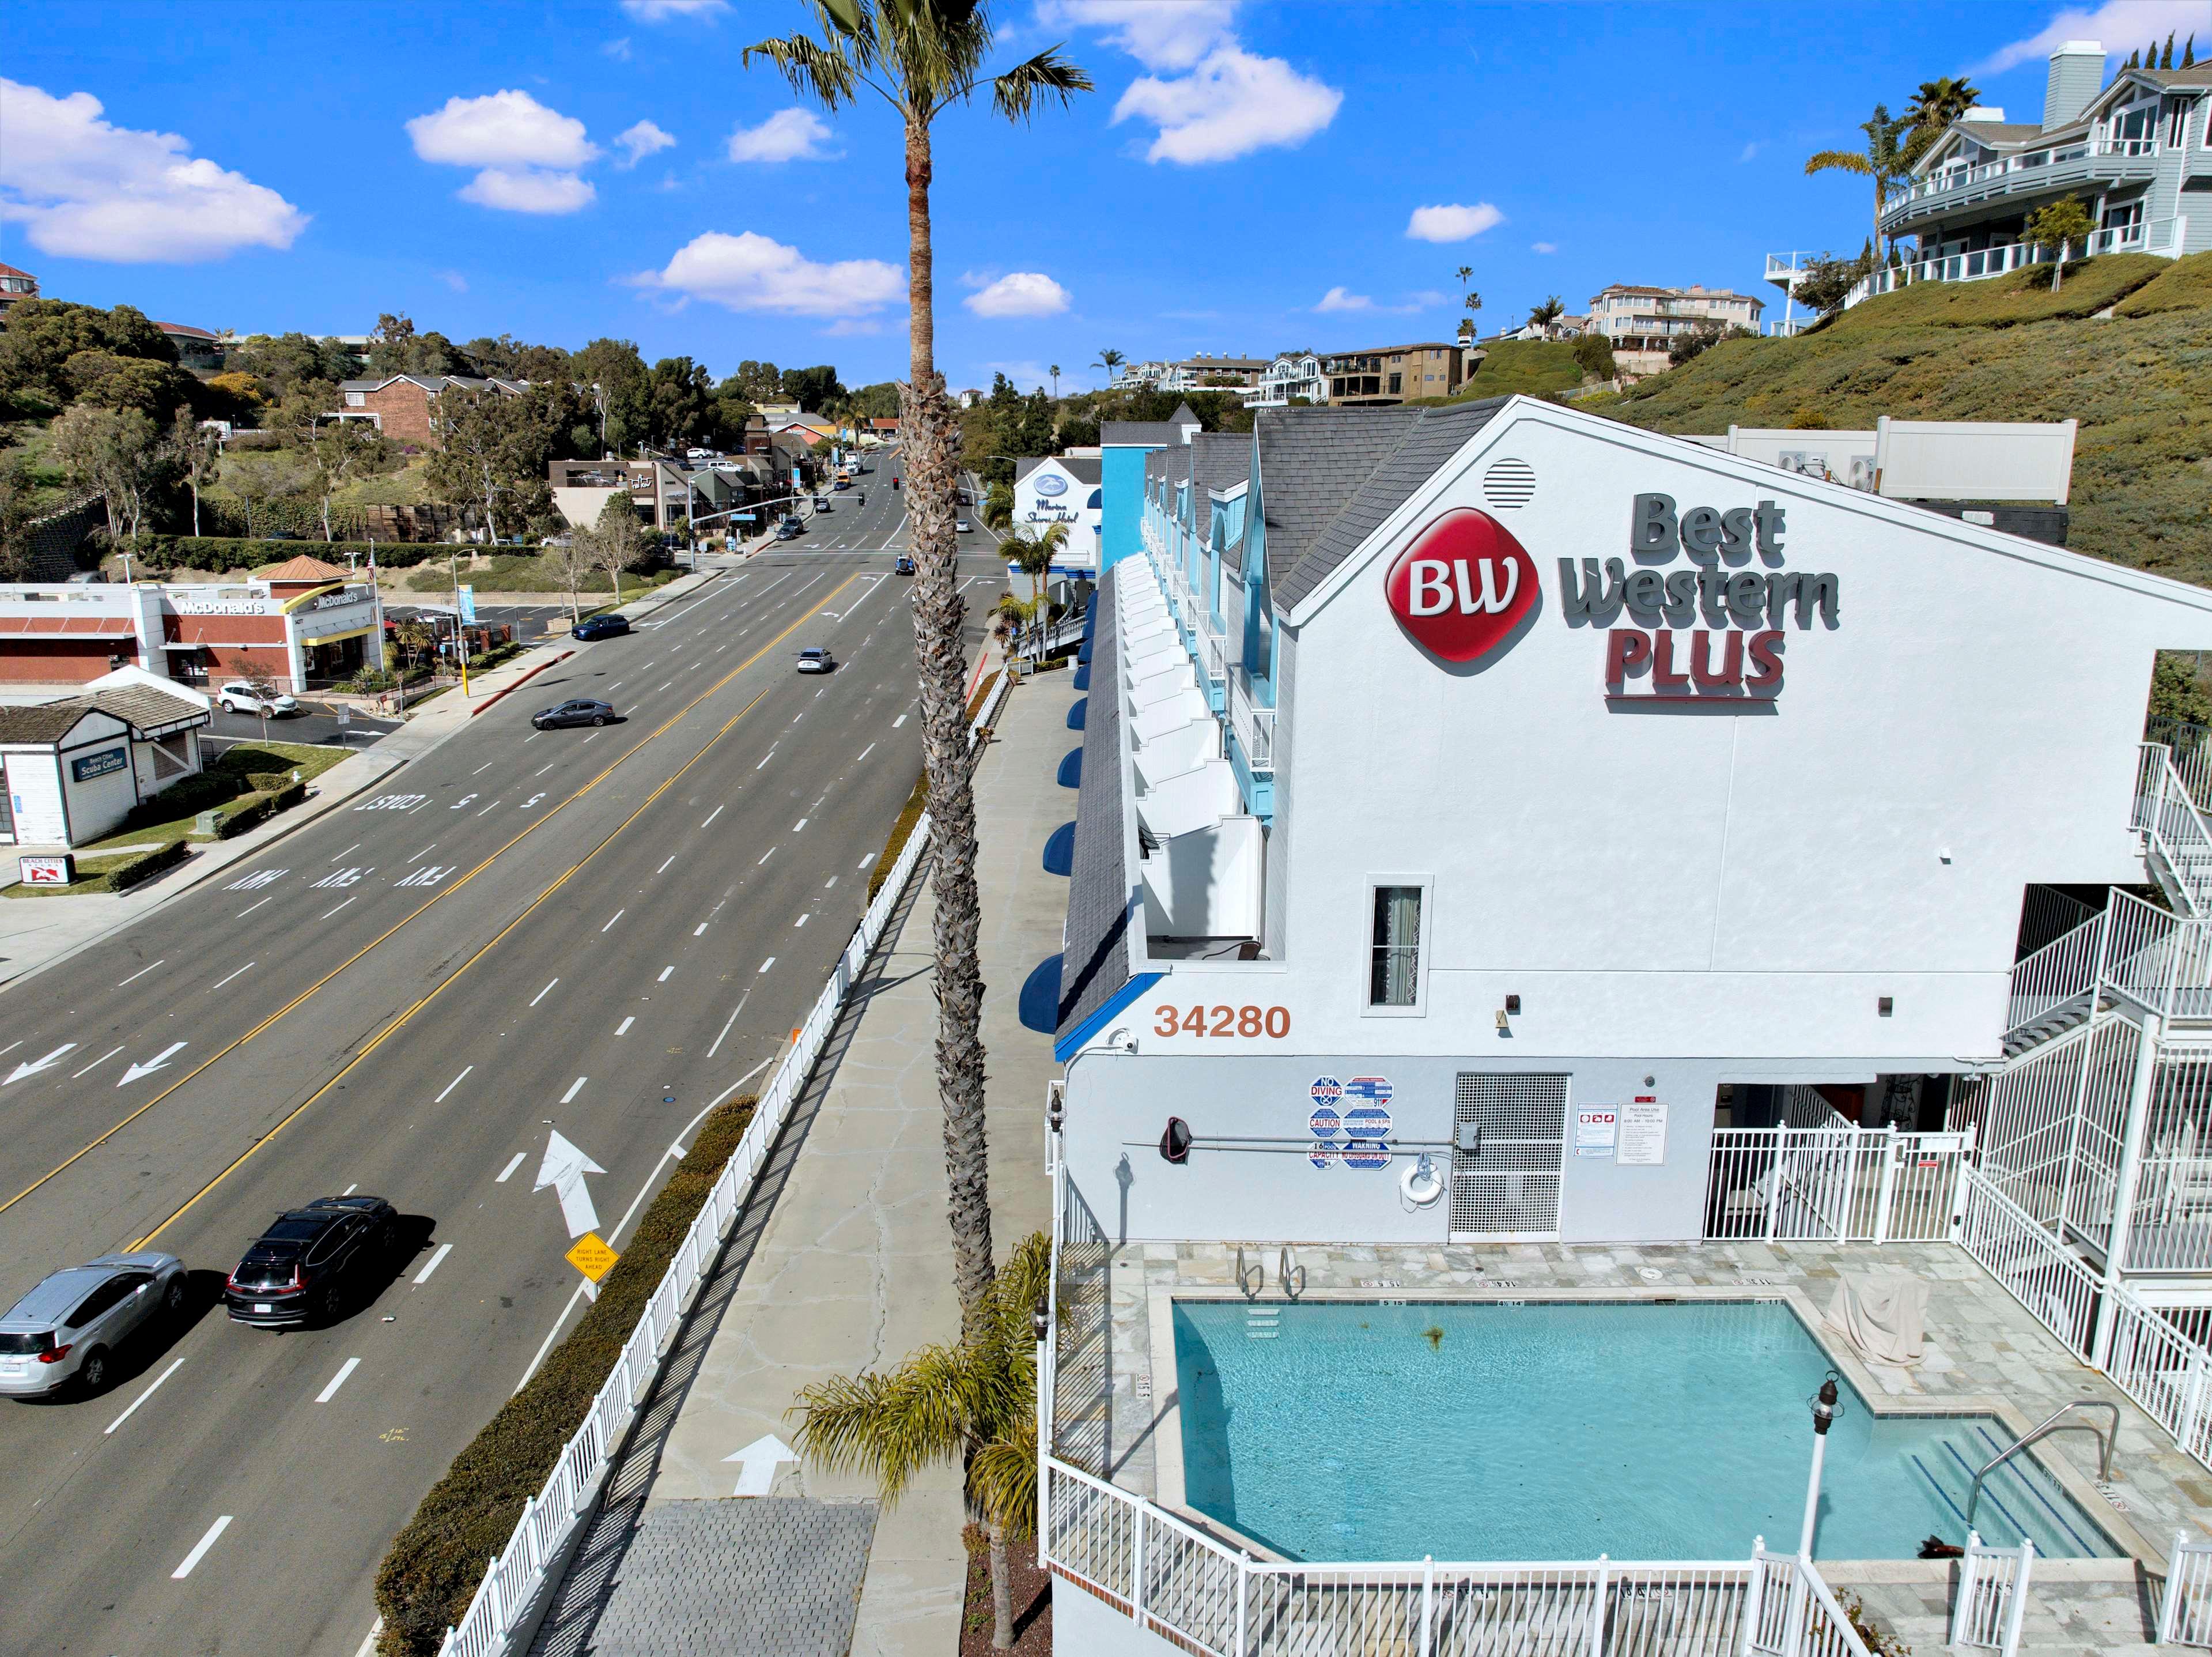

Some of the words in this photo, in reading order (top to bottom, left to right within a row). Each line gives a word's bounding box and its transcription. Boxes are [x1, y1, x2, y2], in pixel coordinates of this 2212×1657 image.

[1036, 499, 1067, 511] Marina
[1025, 511, 1052, 523] Shores
[1052, 511, 1079, 523] Hotel
[1631, 493, 1785, 552] Best
[1409, 557, 1519, 616] BW
[1557, 557, 1840, 617] Western
[182, 601, 265, 614] McDonald's
[319, 592, 358, 609] McDonald's
[1606, 629, 1785, 686] PLUS
[81, 764, 101, 775] Scuba
[103, 757, 123, 769] Center
[353, 794, 426, 811] COAST
[450, 794, 478, 809] 5
[520, 792, 546, 808] 5
[1154, 1005, 1291, 1039] 34280
[1321, 1077, 1334, 1086] NO
[1311, 1086, 1342, 1096] DIVING
[1374, 1098, 1382, 1107] 911
[1310, 1119, 1340, 1127] CAUTION
